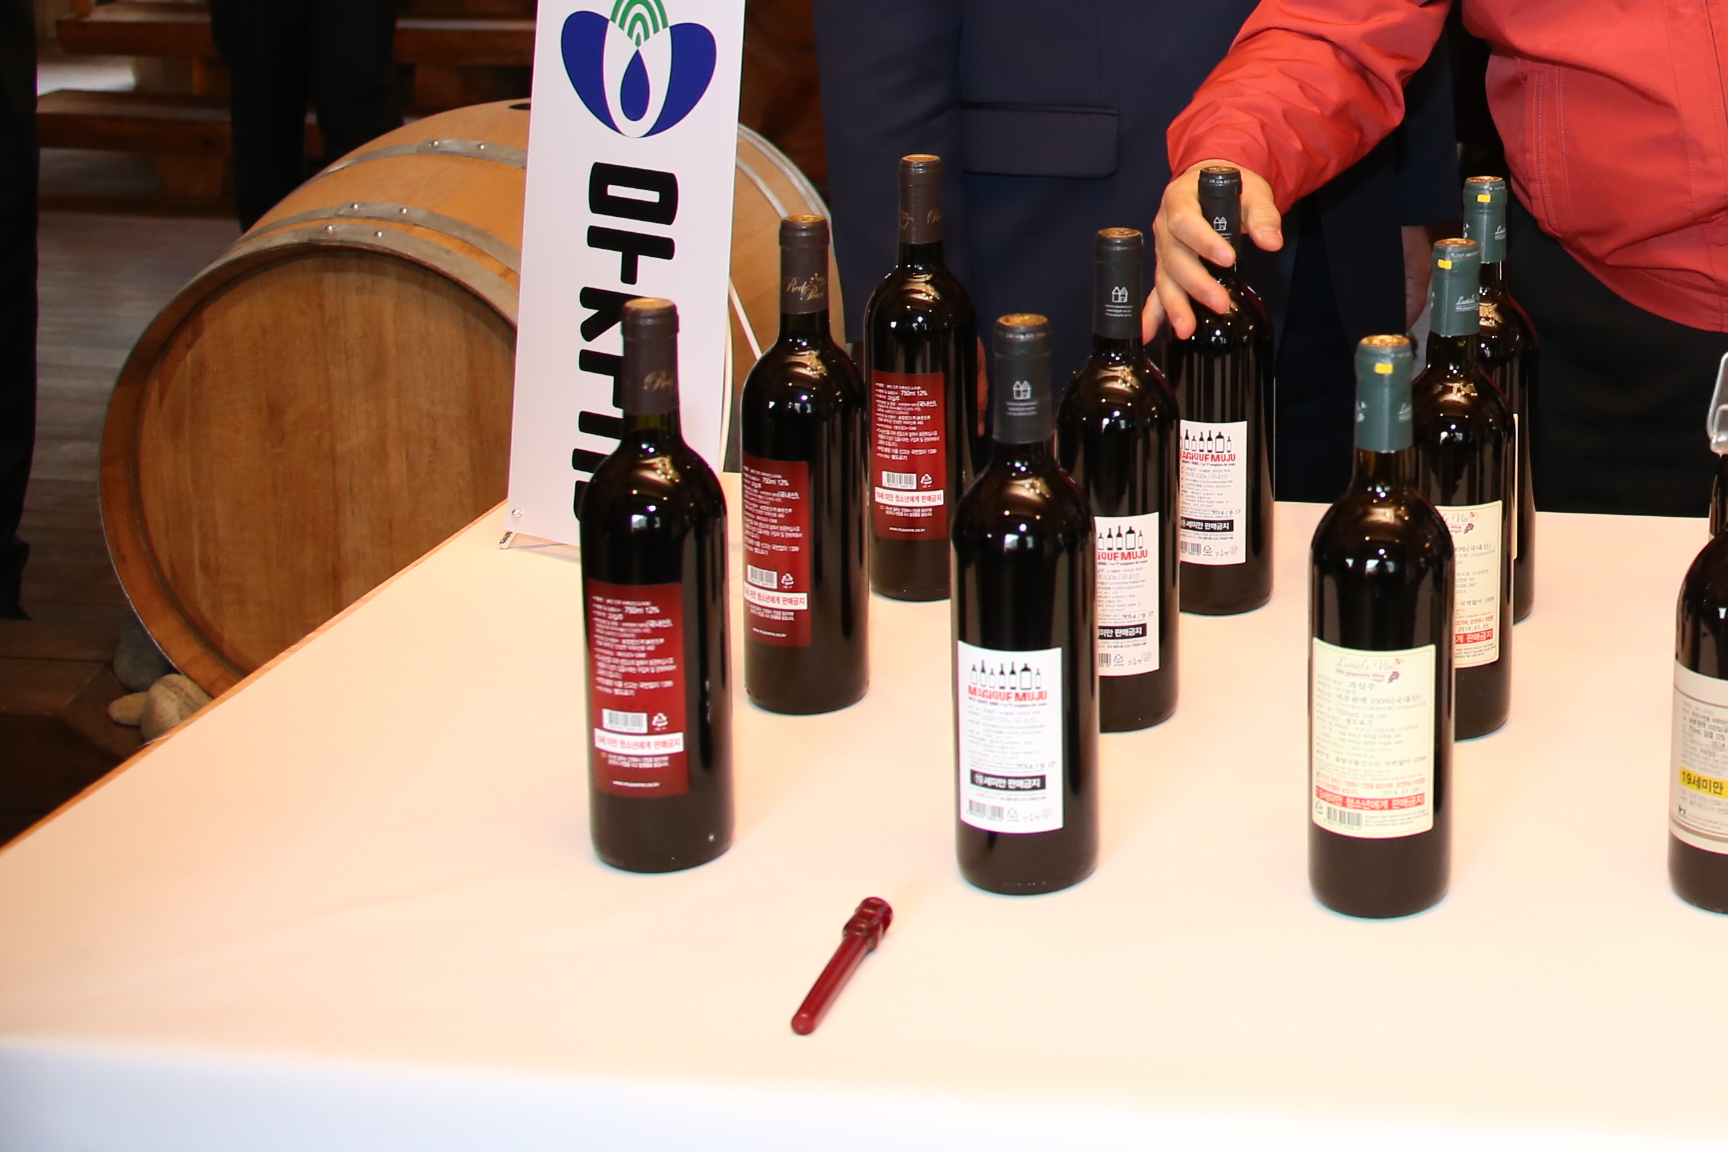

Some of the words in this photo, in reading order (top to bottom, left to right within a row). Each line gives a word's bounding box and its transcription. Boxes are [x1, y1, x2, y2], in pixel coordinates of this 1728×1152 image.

[1211, 453, 1236, 462] MUJU
[895, 494, 920, 503] 청소년에게
[921, 493, 942, 502] 판매금지
[1204, 522, 1230, 530] 판매금지
[1121, 549, 1148, 560] MUJU
[757, 592, 780, 604] 청소년에게
[782, 596, 805, 606] 판매금지
[1115, 626, 1142, 637] 판매금지
[1466, 630, 1493, 642] 판매금지
[1348, 682, 1375, 690] 과실주
[1015, 690, 1048, 701] MUJU
[620, 738, 651, 750] 청소년에게
[654, 737, 680, 750] 판매금지
[1007, 777, 1041, 789] 판매금지
[1681, 770, 1723, 795] 19세미만
[1345, 798, 1388, 810] 청소년에게
[1391, 794, 1424, 809] 판매금지
